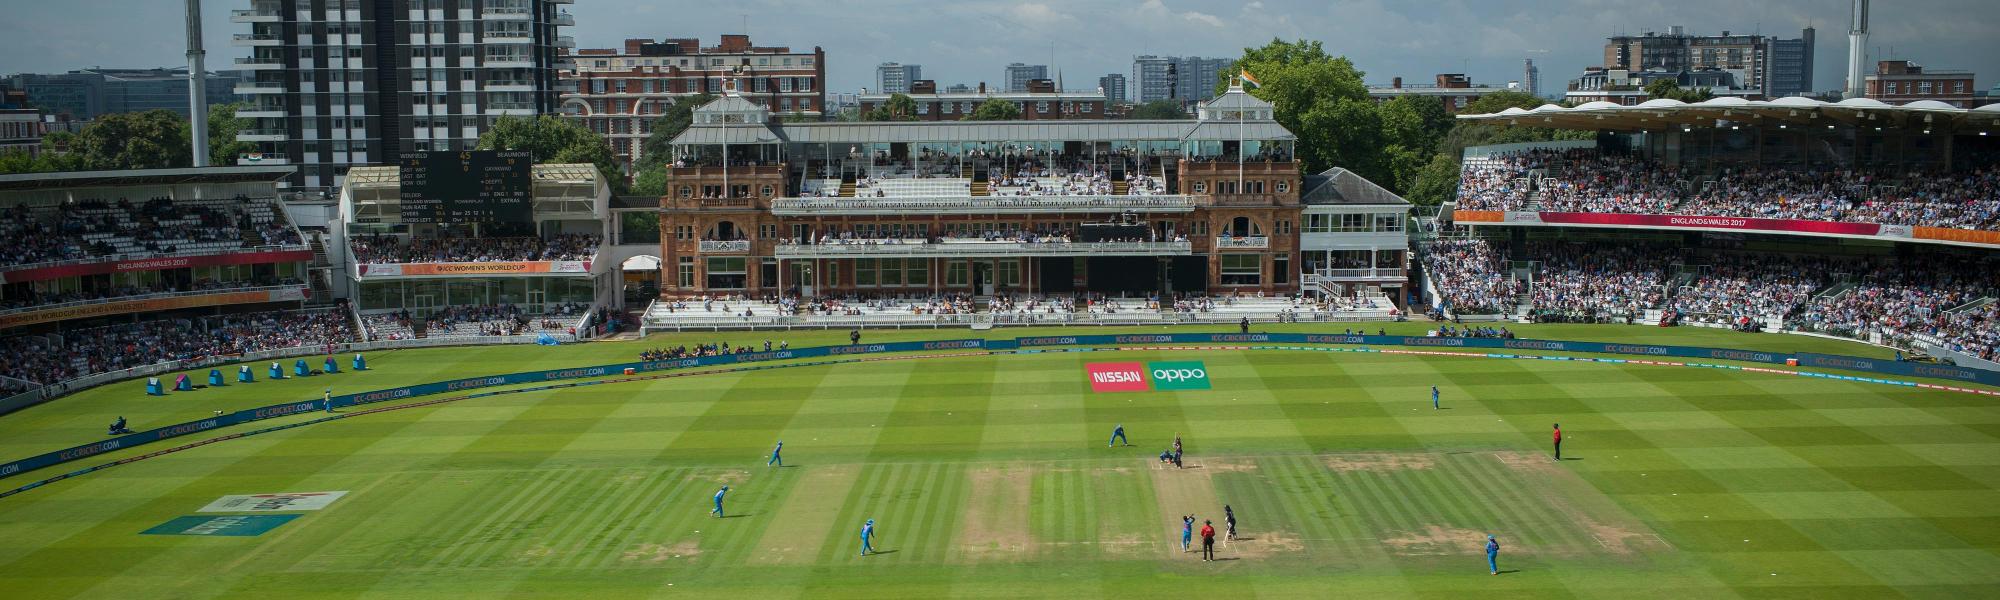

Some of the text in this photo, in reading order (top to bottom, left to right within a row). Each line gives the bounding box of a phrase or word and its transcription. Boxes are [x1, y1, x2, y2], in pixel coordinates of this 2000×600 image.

[41, 311, 64, 320] WORLD
[109, 304, 132, 312] WALES
[1020, 336, 1076, 346] ICC-CRICKET.COM
[1116, 335, 1172, 344] ICC-CRICKET.COM
[1210, 334, 1268, 342] ICC-CRICKET.COM
[1307, 335, 1364, 345] ICC-CRICKET.COM
[1405, 337, 1464, 347] ICC-CRICKET.COM
[829, 345, 886, 355] ICC-CRICKET.COM
[924, 341, 980, 350] ICC-CRICKET.COM
[1504, 340, 1564, 350] ICC-CRICKET.COM
[1605, 345, 1666, 355] ICC-CRICKET.COM
[736, 351, 792, 362] ICC-CRICKET.COM
[1712, 350, 1772, 361] ICC-CRICKET.COM
[643, 358, 698, 370] ICC-CRICKET.COM
[1815, 358, 1872, 370] ICC-CRICKET.COM
[546, 367, 604, 380] ICC-CRICKET.COM
[1094, 371, 1141, 382] NISSAN
[1914, 367, 1976, 380] ICC-CRICKET.COM
[448, 376, 505, 391] ICC-CRICKET.COM
[354, 388, 410, 403] ICC-CRICKET.COM
[256, 402, 314, 418] ICC-CRICKET.COM
[159, 419, 216, 438] ICC-CRICKET.COM
[60, 440, 120, 460] ICC-CRICKET.COM
